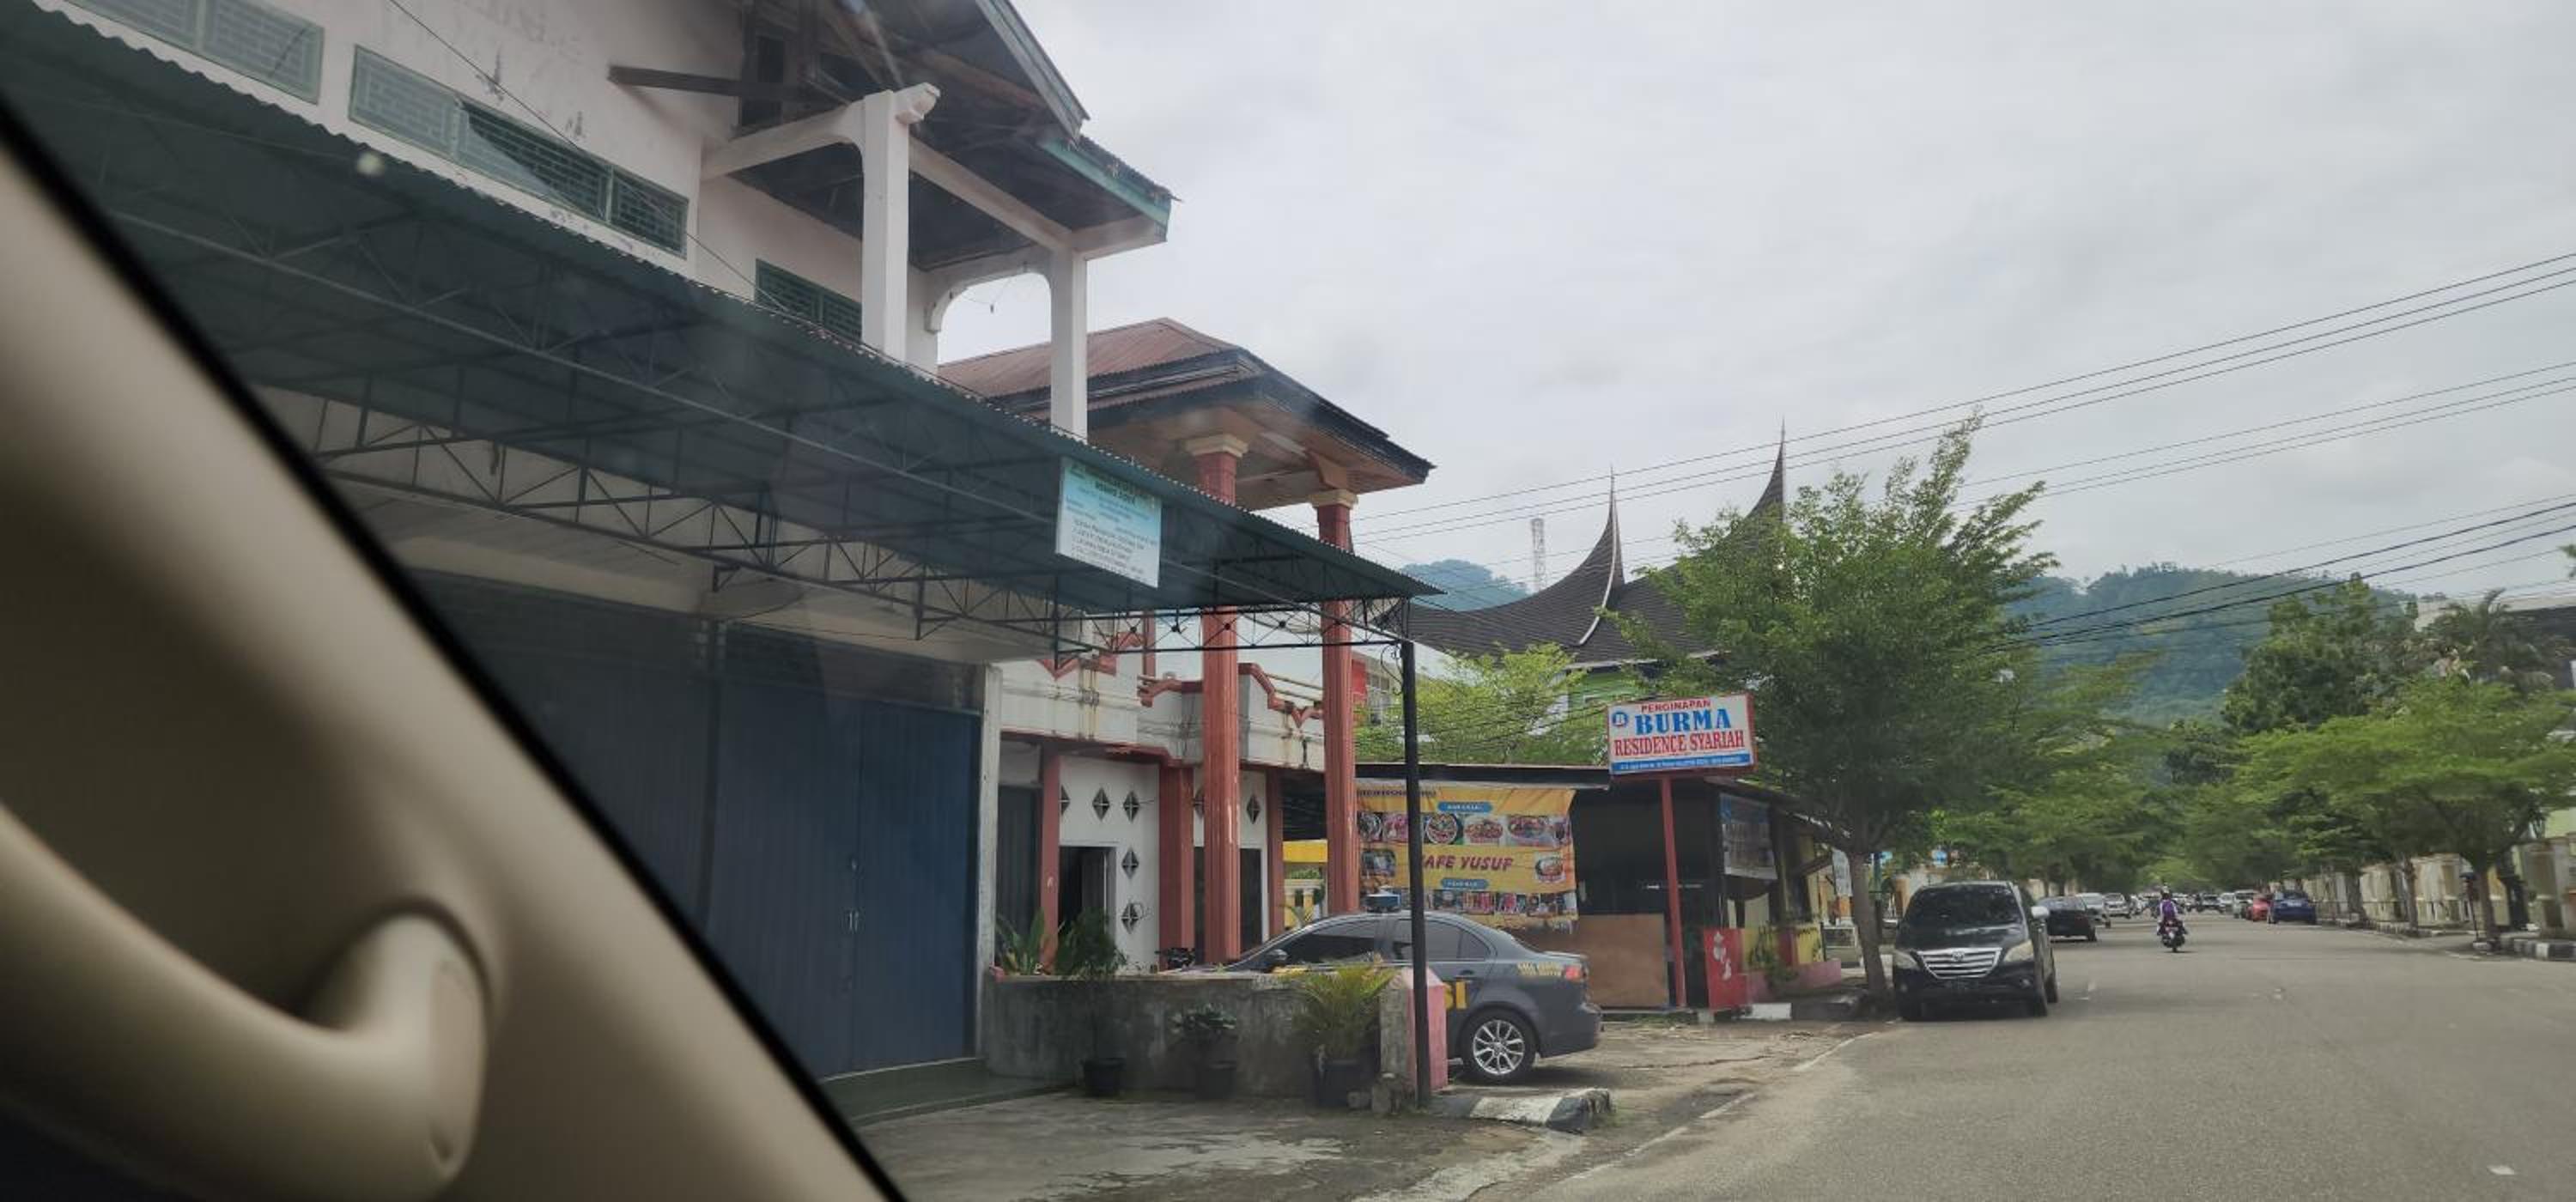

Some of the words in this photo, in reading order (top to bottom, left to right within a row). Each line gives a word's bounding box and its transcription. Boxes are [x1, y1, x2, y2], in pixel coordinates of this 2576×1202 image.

[1641, 700, 1711, 713] PENGINAPAN
[1634, 708, 1731, 736] BURMA
[1614, 734, 1687, 756] RESIDENCE
[1689, 730, 1745, 751] SYARIAH
[1422, 855, 1457, 869] AFE
[1461, 856, 1514, 871] YUSUF
